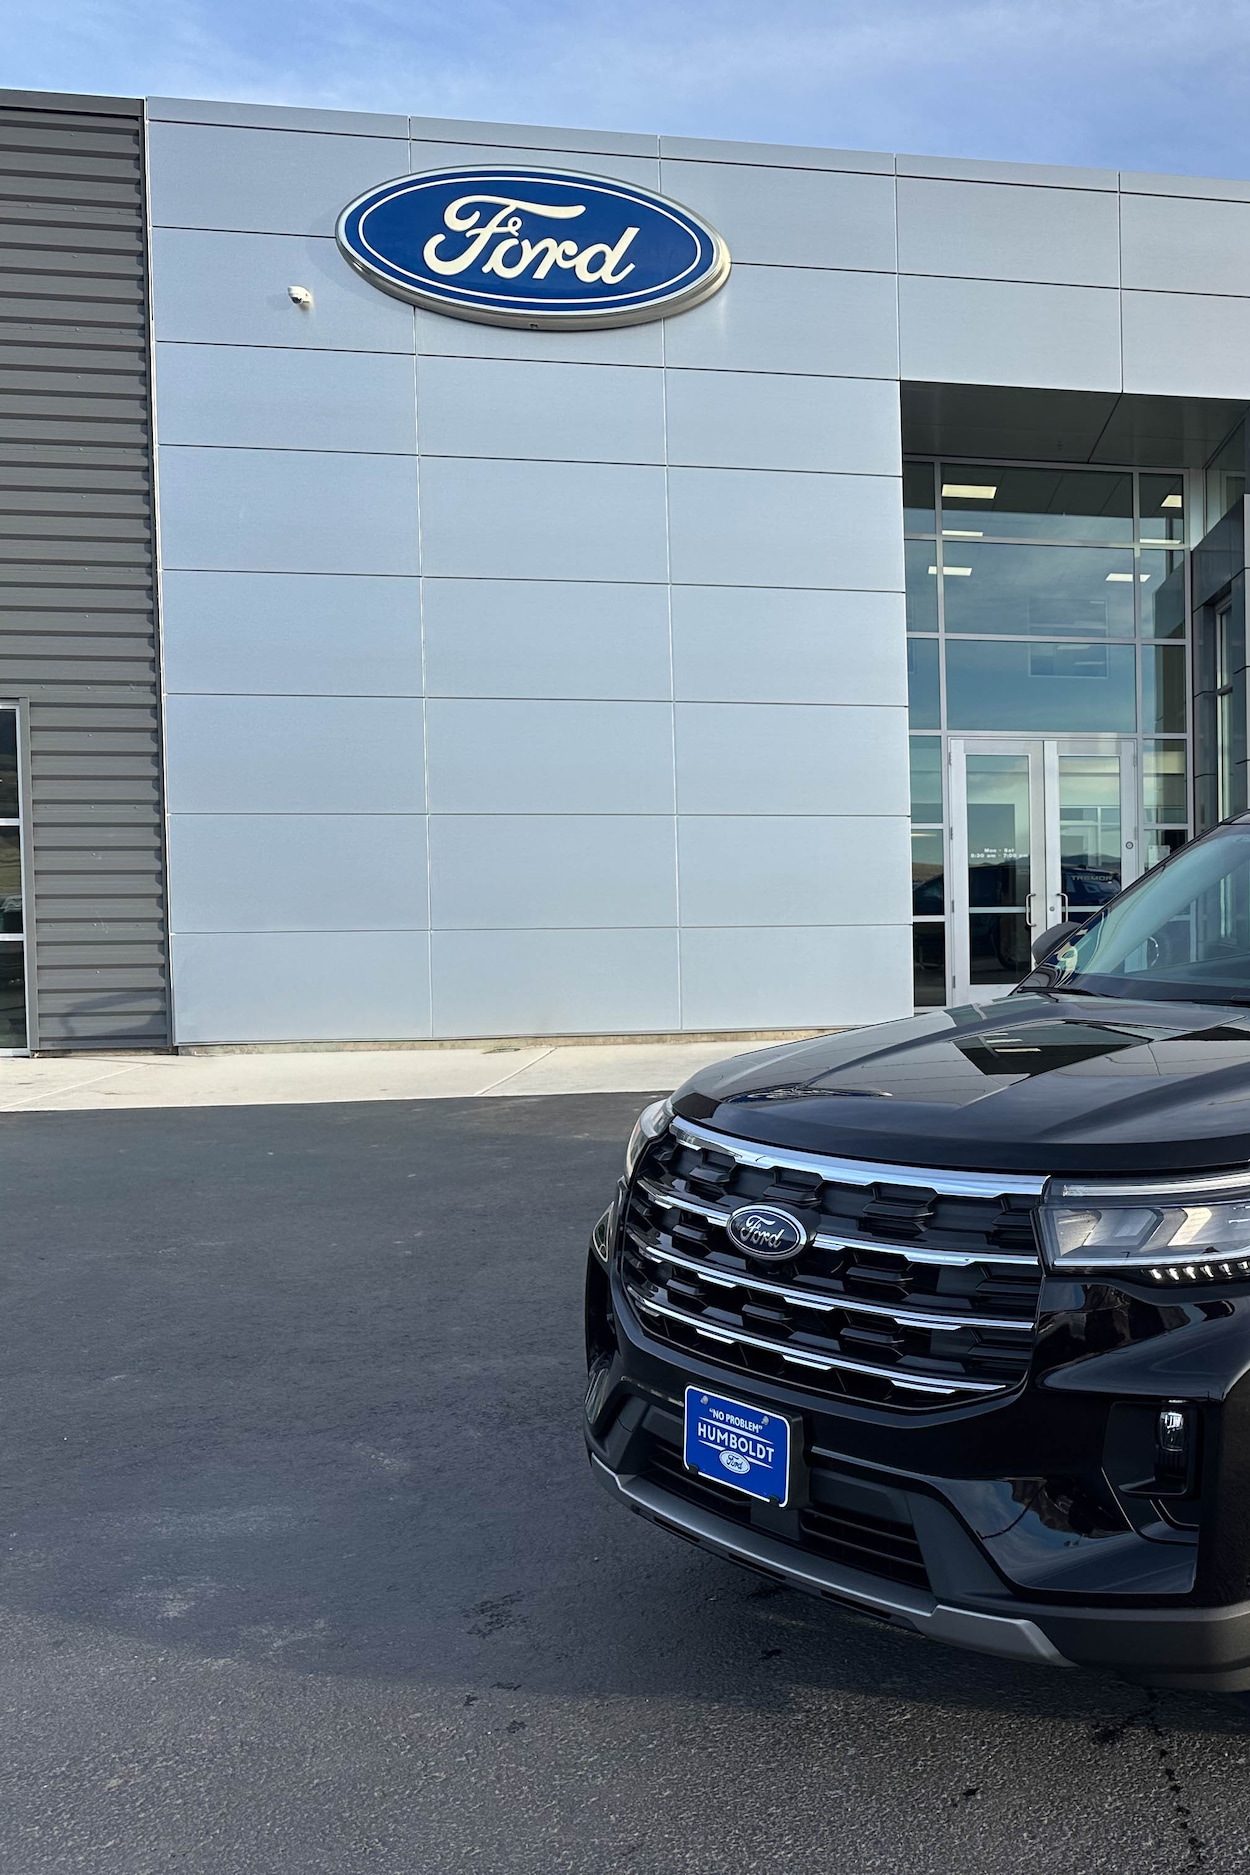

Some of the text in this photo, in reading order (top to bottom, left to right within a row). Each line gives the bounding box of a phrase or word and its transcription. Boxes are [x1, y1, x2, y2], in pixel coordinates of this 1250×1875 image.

[423, 194, 640, 285] Ford
[740, 1215, 785, 1249] Ford
[697, 1422, 775, 1462] HUMBOLDT
[726, 1453, 743, 1470] Ford
